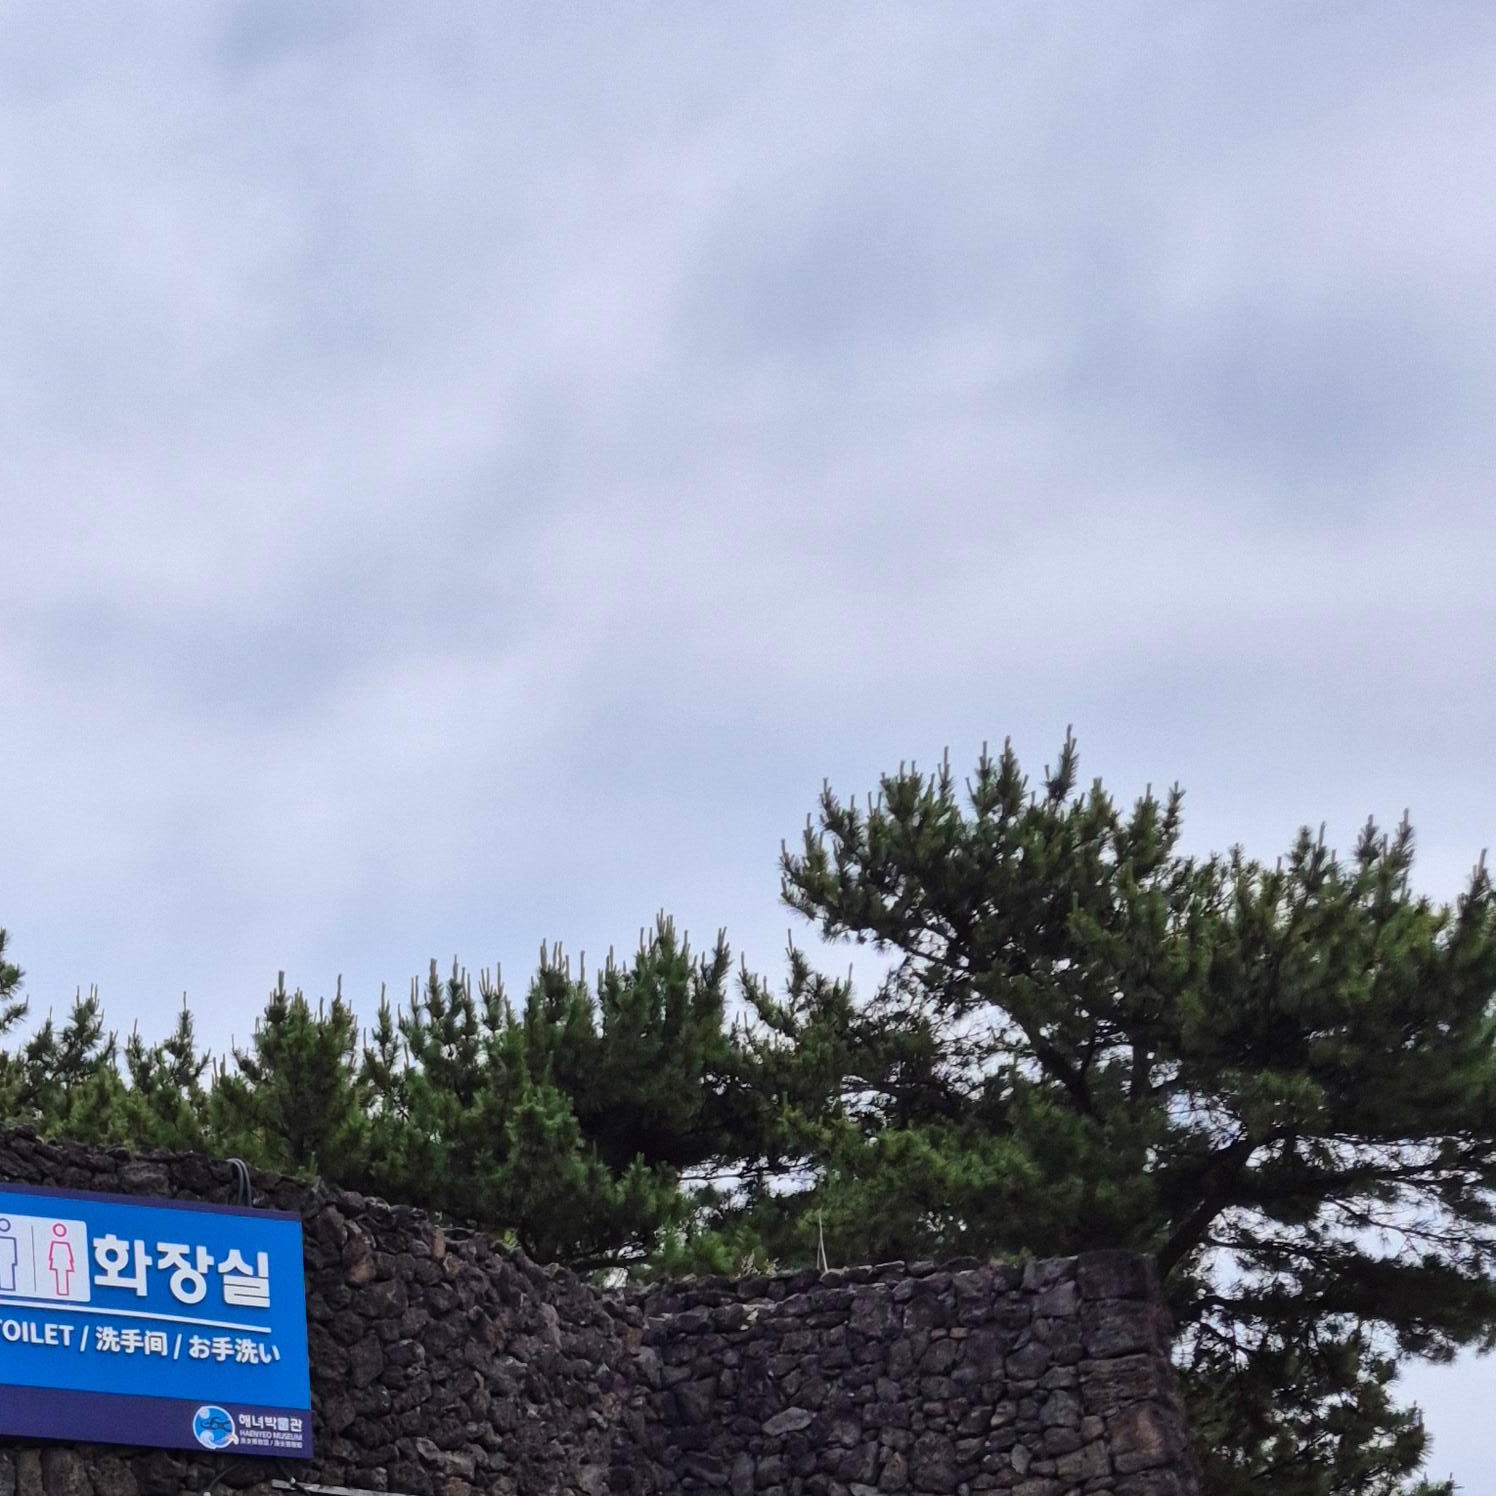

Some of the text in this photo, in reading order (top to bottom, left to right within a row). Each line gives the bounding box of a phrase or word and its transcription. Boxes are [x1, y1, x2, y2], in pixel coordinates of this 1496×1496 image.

[92, 1233, 272, 1308] 화장실
[95, 1325, 168, 1356] 洗手间
[188, 1334, 281, 1364] お手洗い
[239, 1429, 303, 1442] HAENYEO MUSEUM
